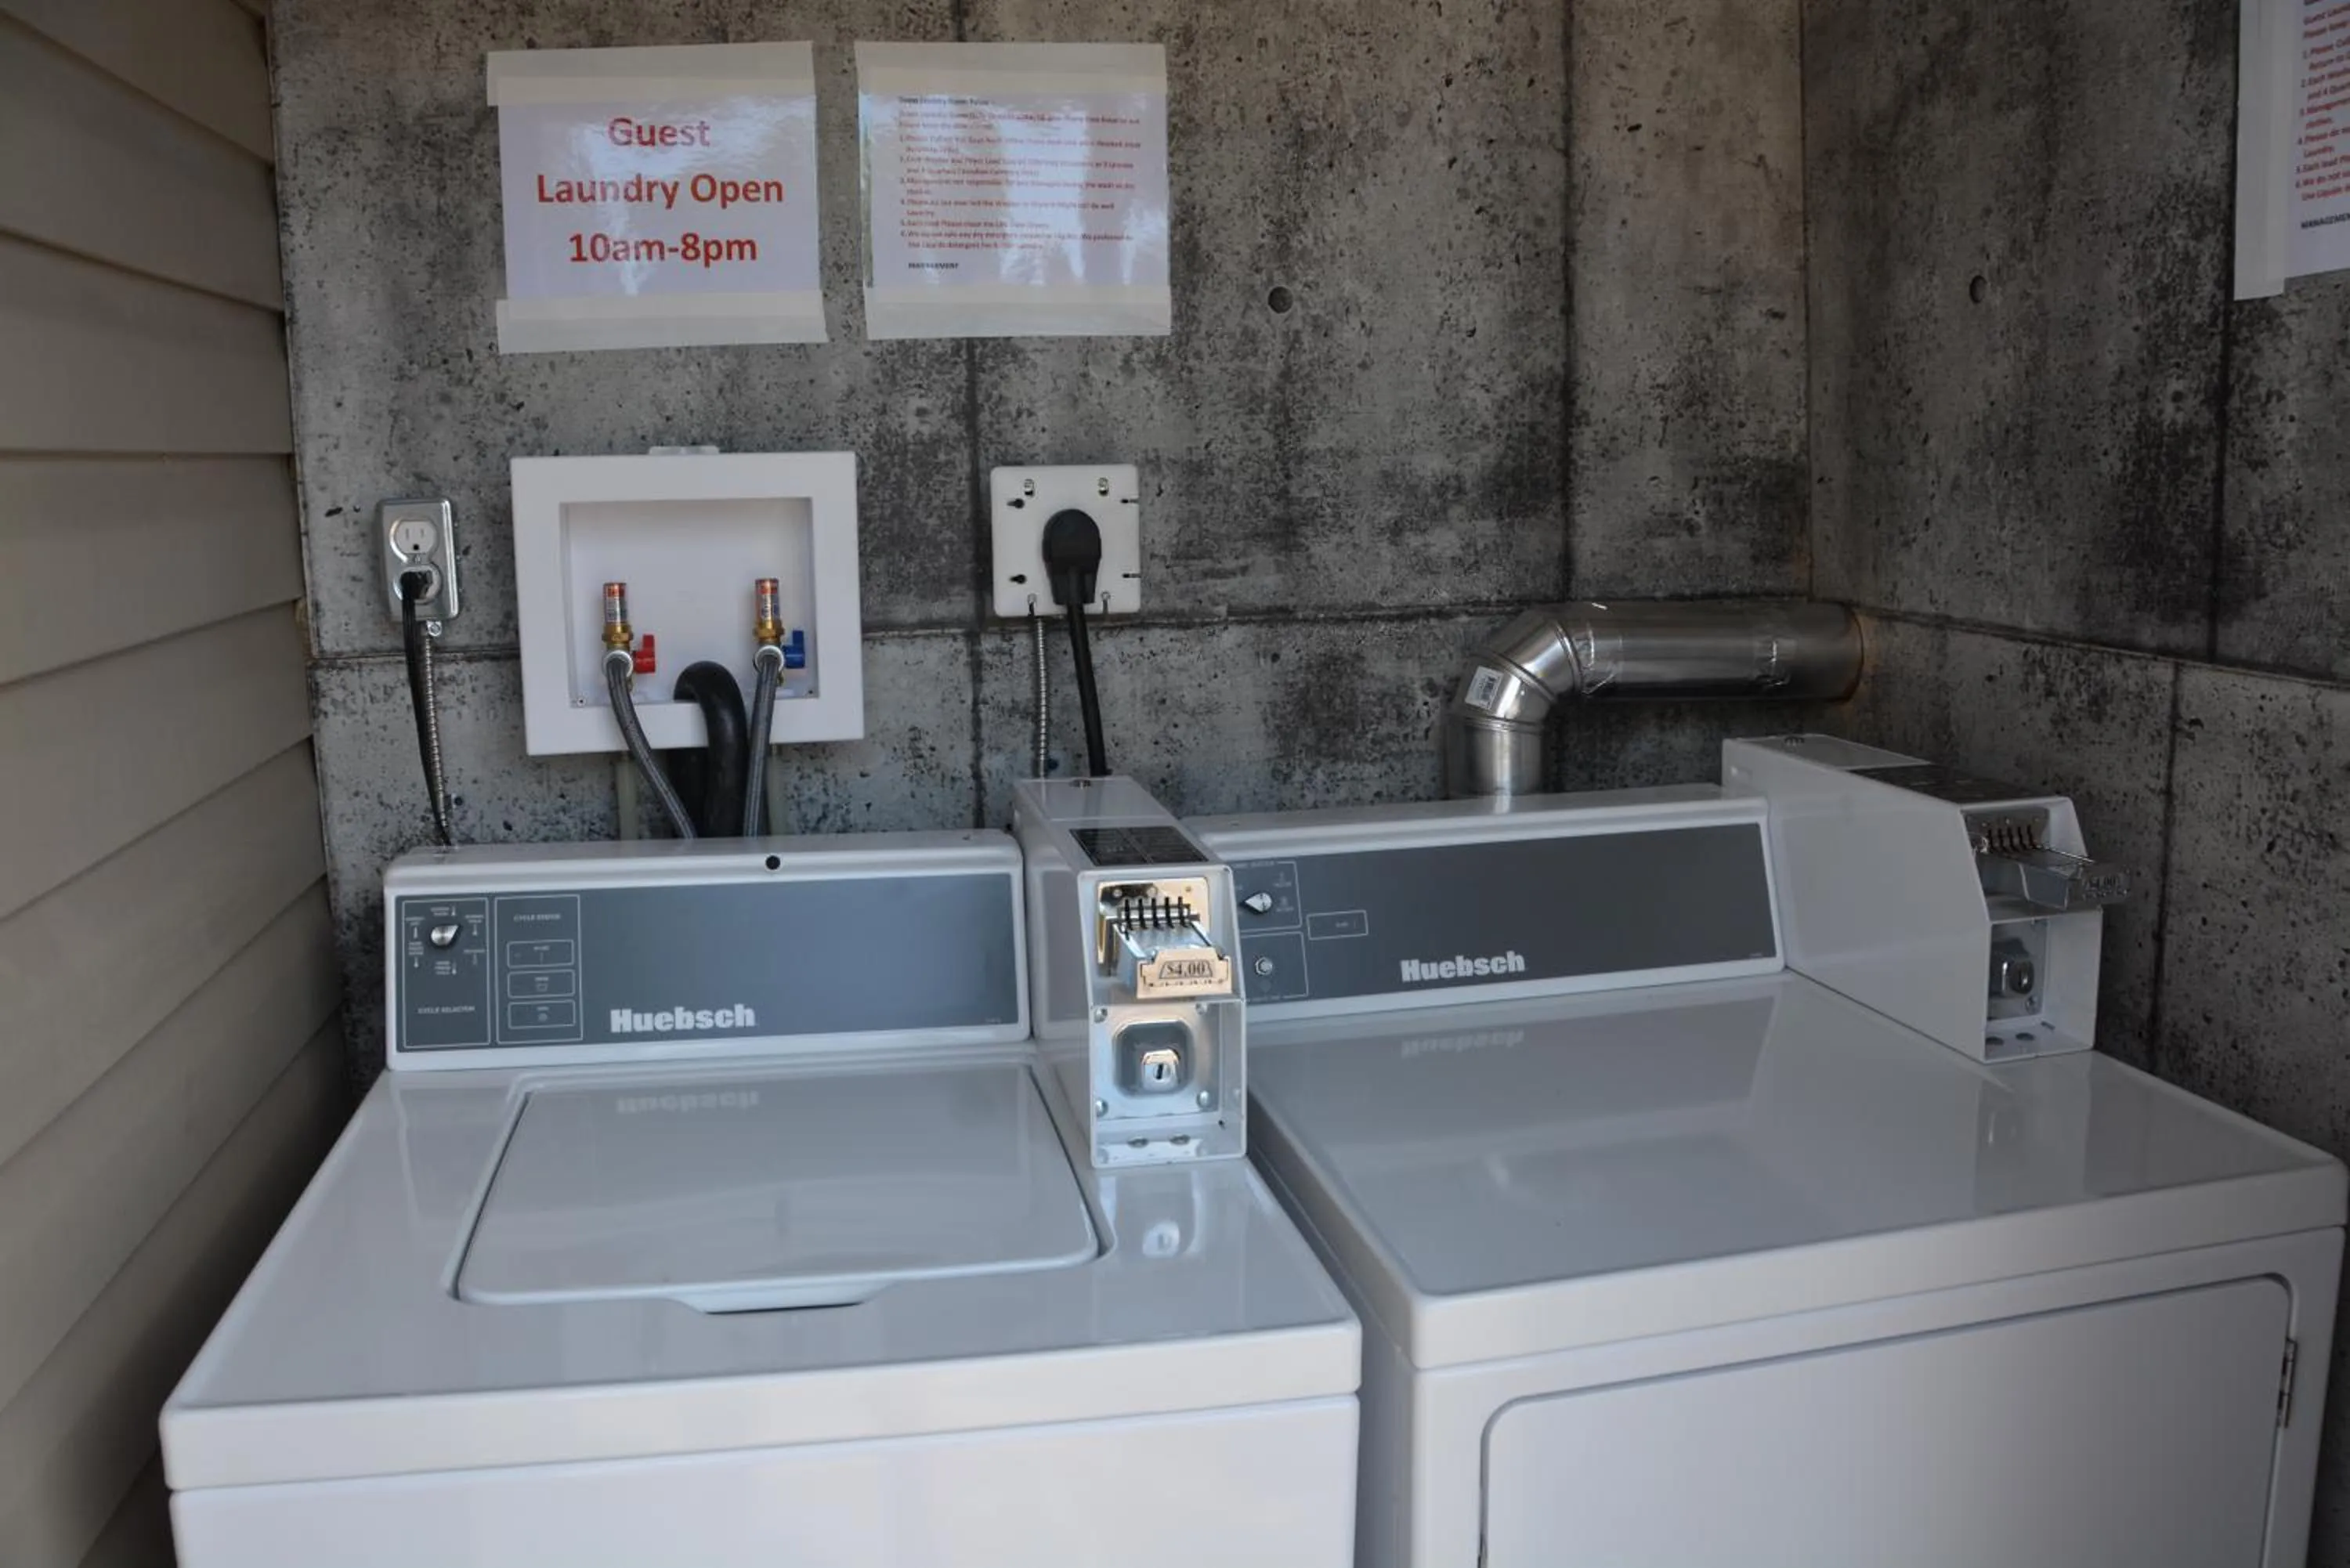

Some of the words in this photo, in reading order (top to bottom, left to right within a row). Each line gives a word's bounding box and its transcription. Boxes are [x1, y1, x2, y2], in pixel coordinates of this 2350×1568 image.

[609, 117, 710, 147] Guest
[537, 174, 680, 209] Laundry
[690, 173, 783, 209] Open
[569, 233, 757, 267] 10am-8pm
[1401, 950, 1525, 983] Huebsch
[610, 1003, 755, 1033] Huebsch
